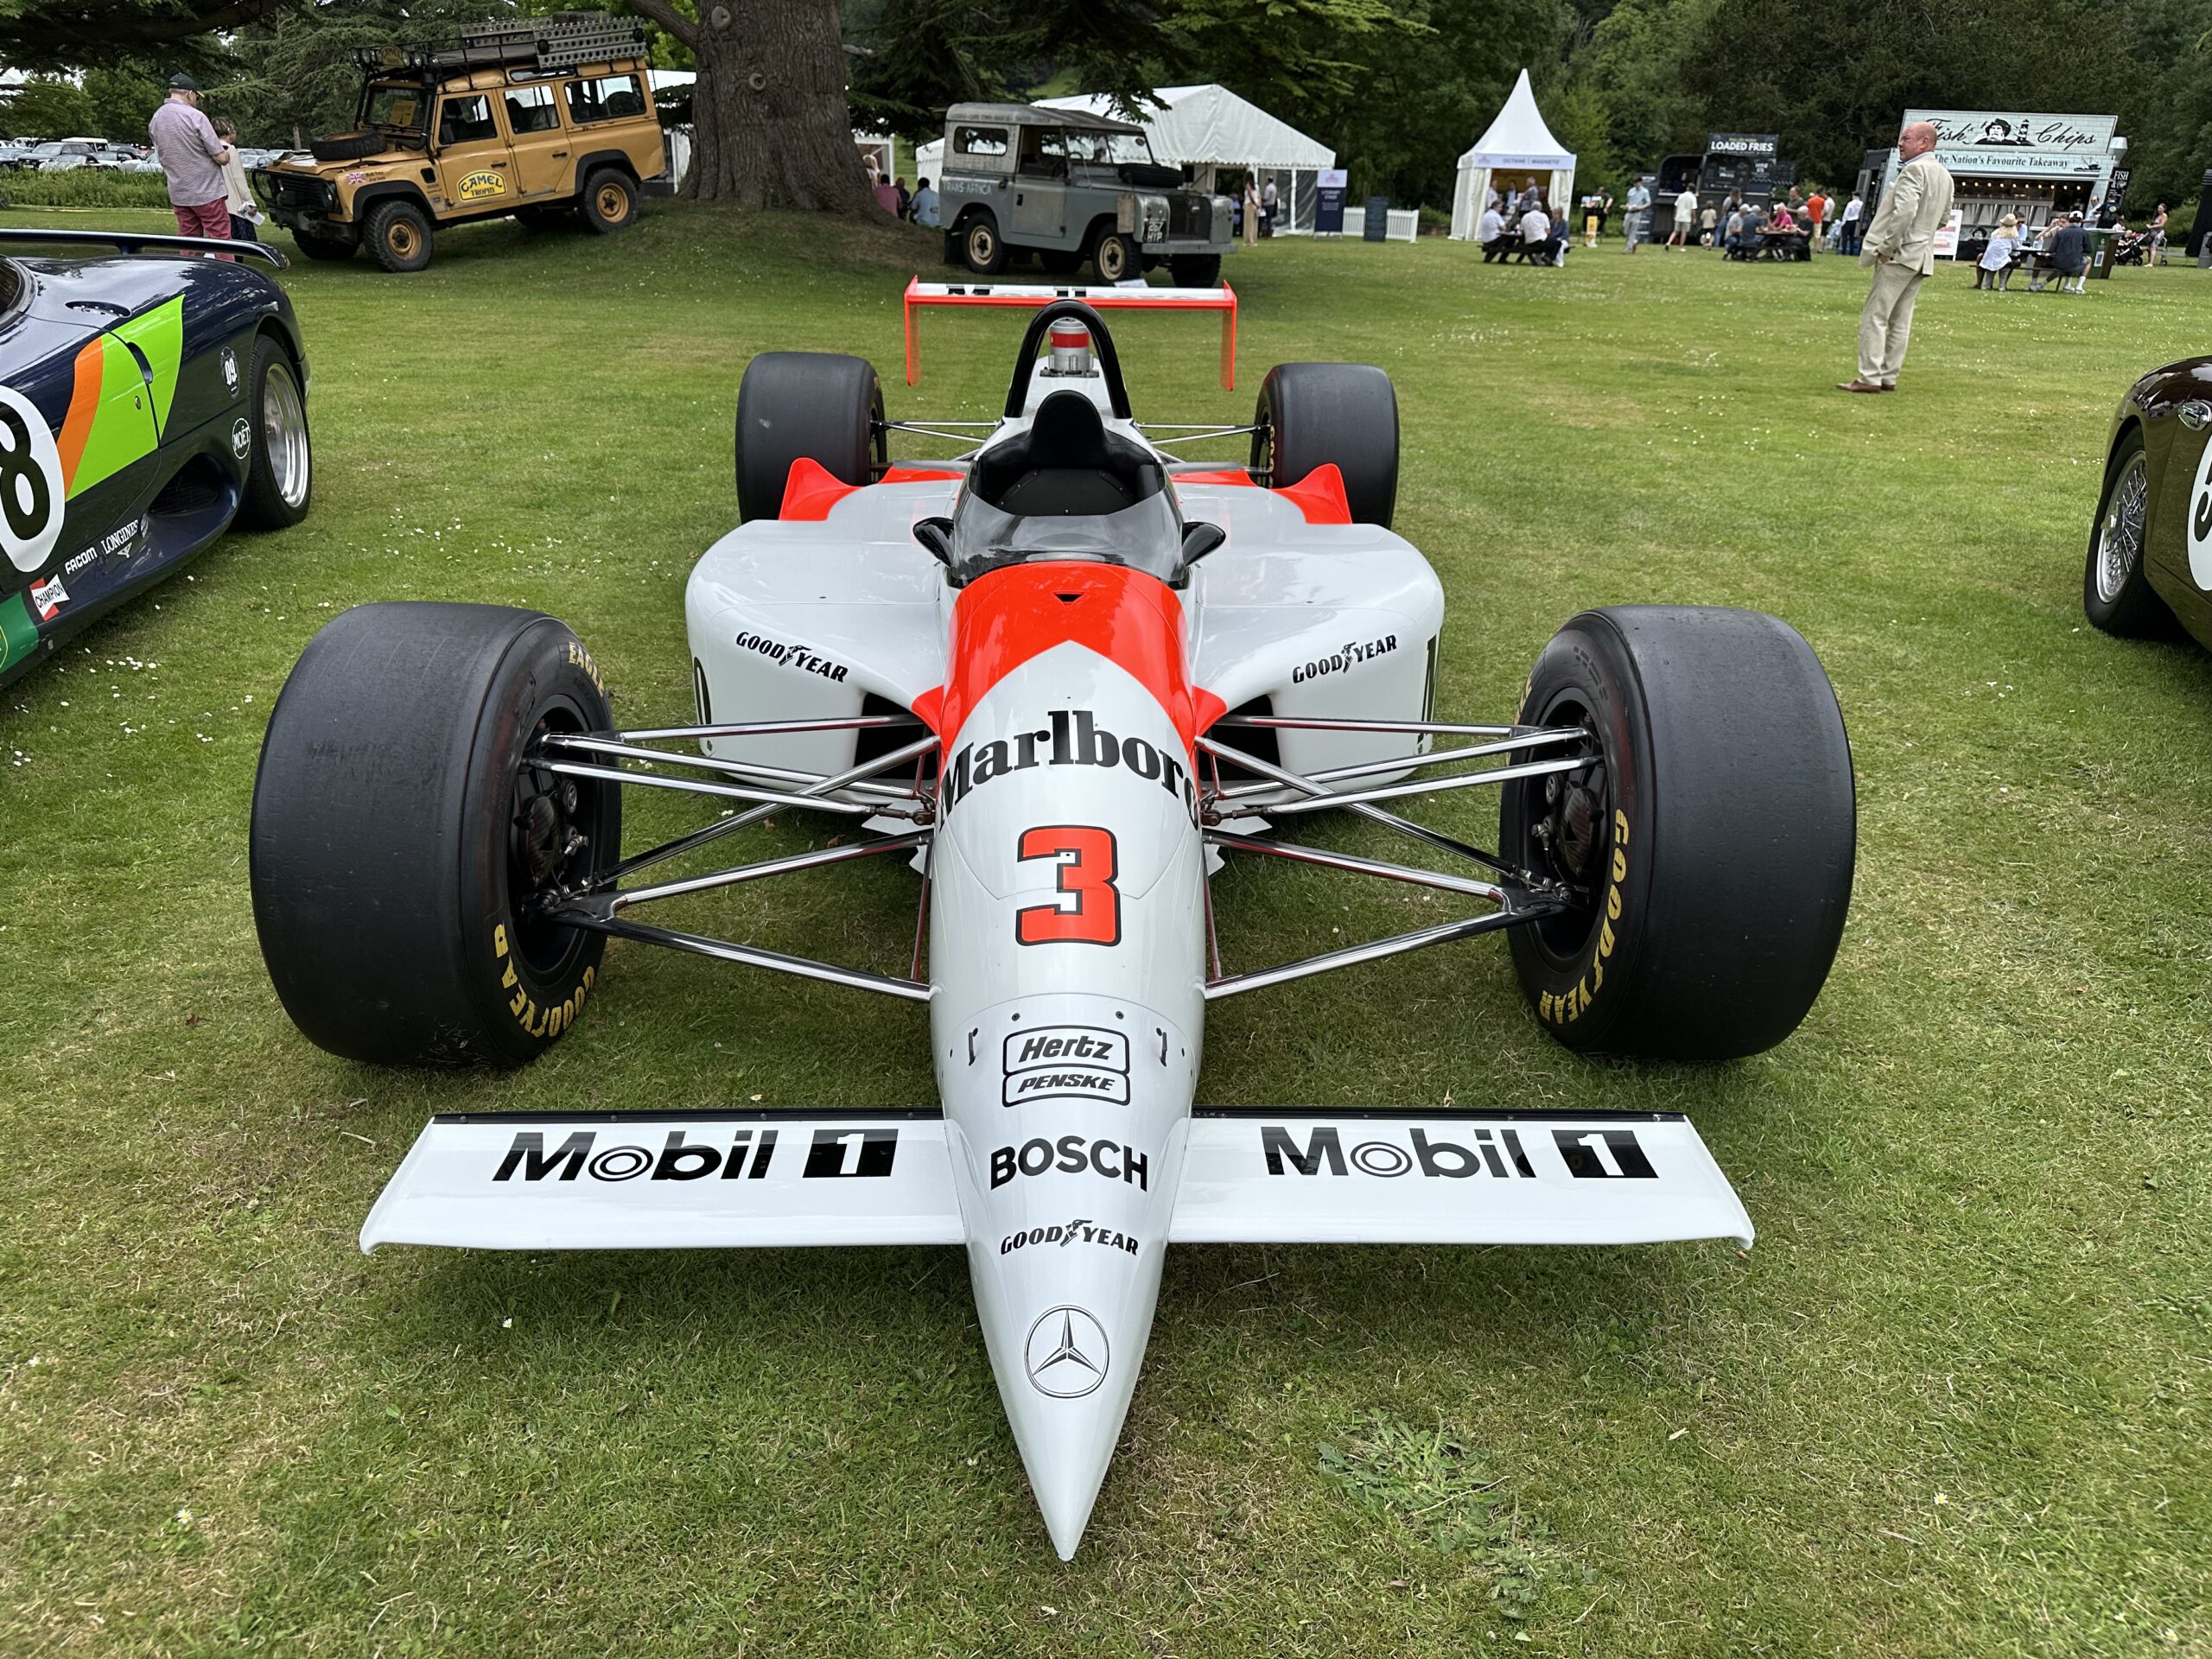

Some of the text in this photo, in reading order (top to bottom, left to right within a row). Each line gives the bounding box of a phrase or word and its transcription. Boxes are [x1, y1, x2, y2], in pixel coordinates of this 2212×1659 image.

[1711, 141, 1774, 152] LOADED FRIES
[2036, 122, 2096, 150] Chips
[1950, 154, 1984, 165] Nation's
[1986, 156, 2026, 166] Favourite
[2028, 156, 2069, 169] Takeaway
[2113, 170, 2129, 181] FISH
[461, 175, 502, 193] CAMEL
[943, 181, 992, 195] TRANS AFRICA
[100, 519, 138, 555] LONGINES
[64, 547, 98, 575] FACOM
[35, 584, 64, 608] CHAMPION
[1015, 824, 1122, 946] 3
[1018, 1035, 1113, 1063] Hertz
[1017, 1074, 1116, 1093] PENSKE
[492, 1129, 779, 1181] Mobil
[990, 1135, 1147, 1192] BOSCH
[1261, 1127, 1536, 1178] Mobil
